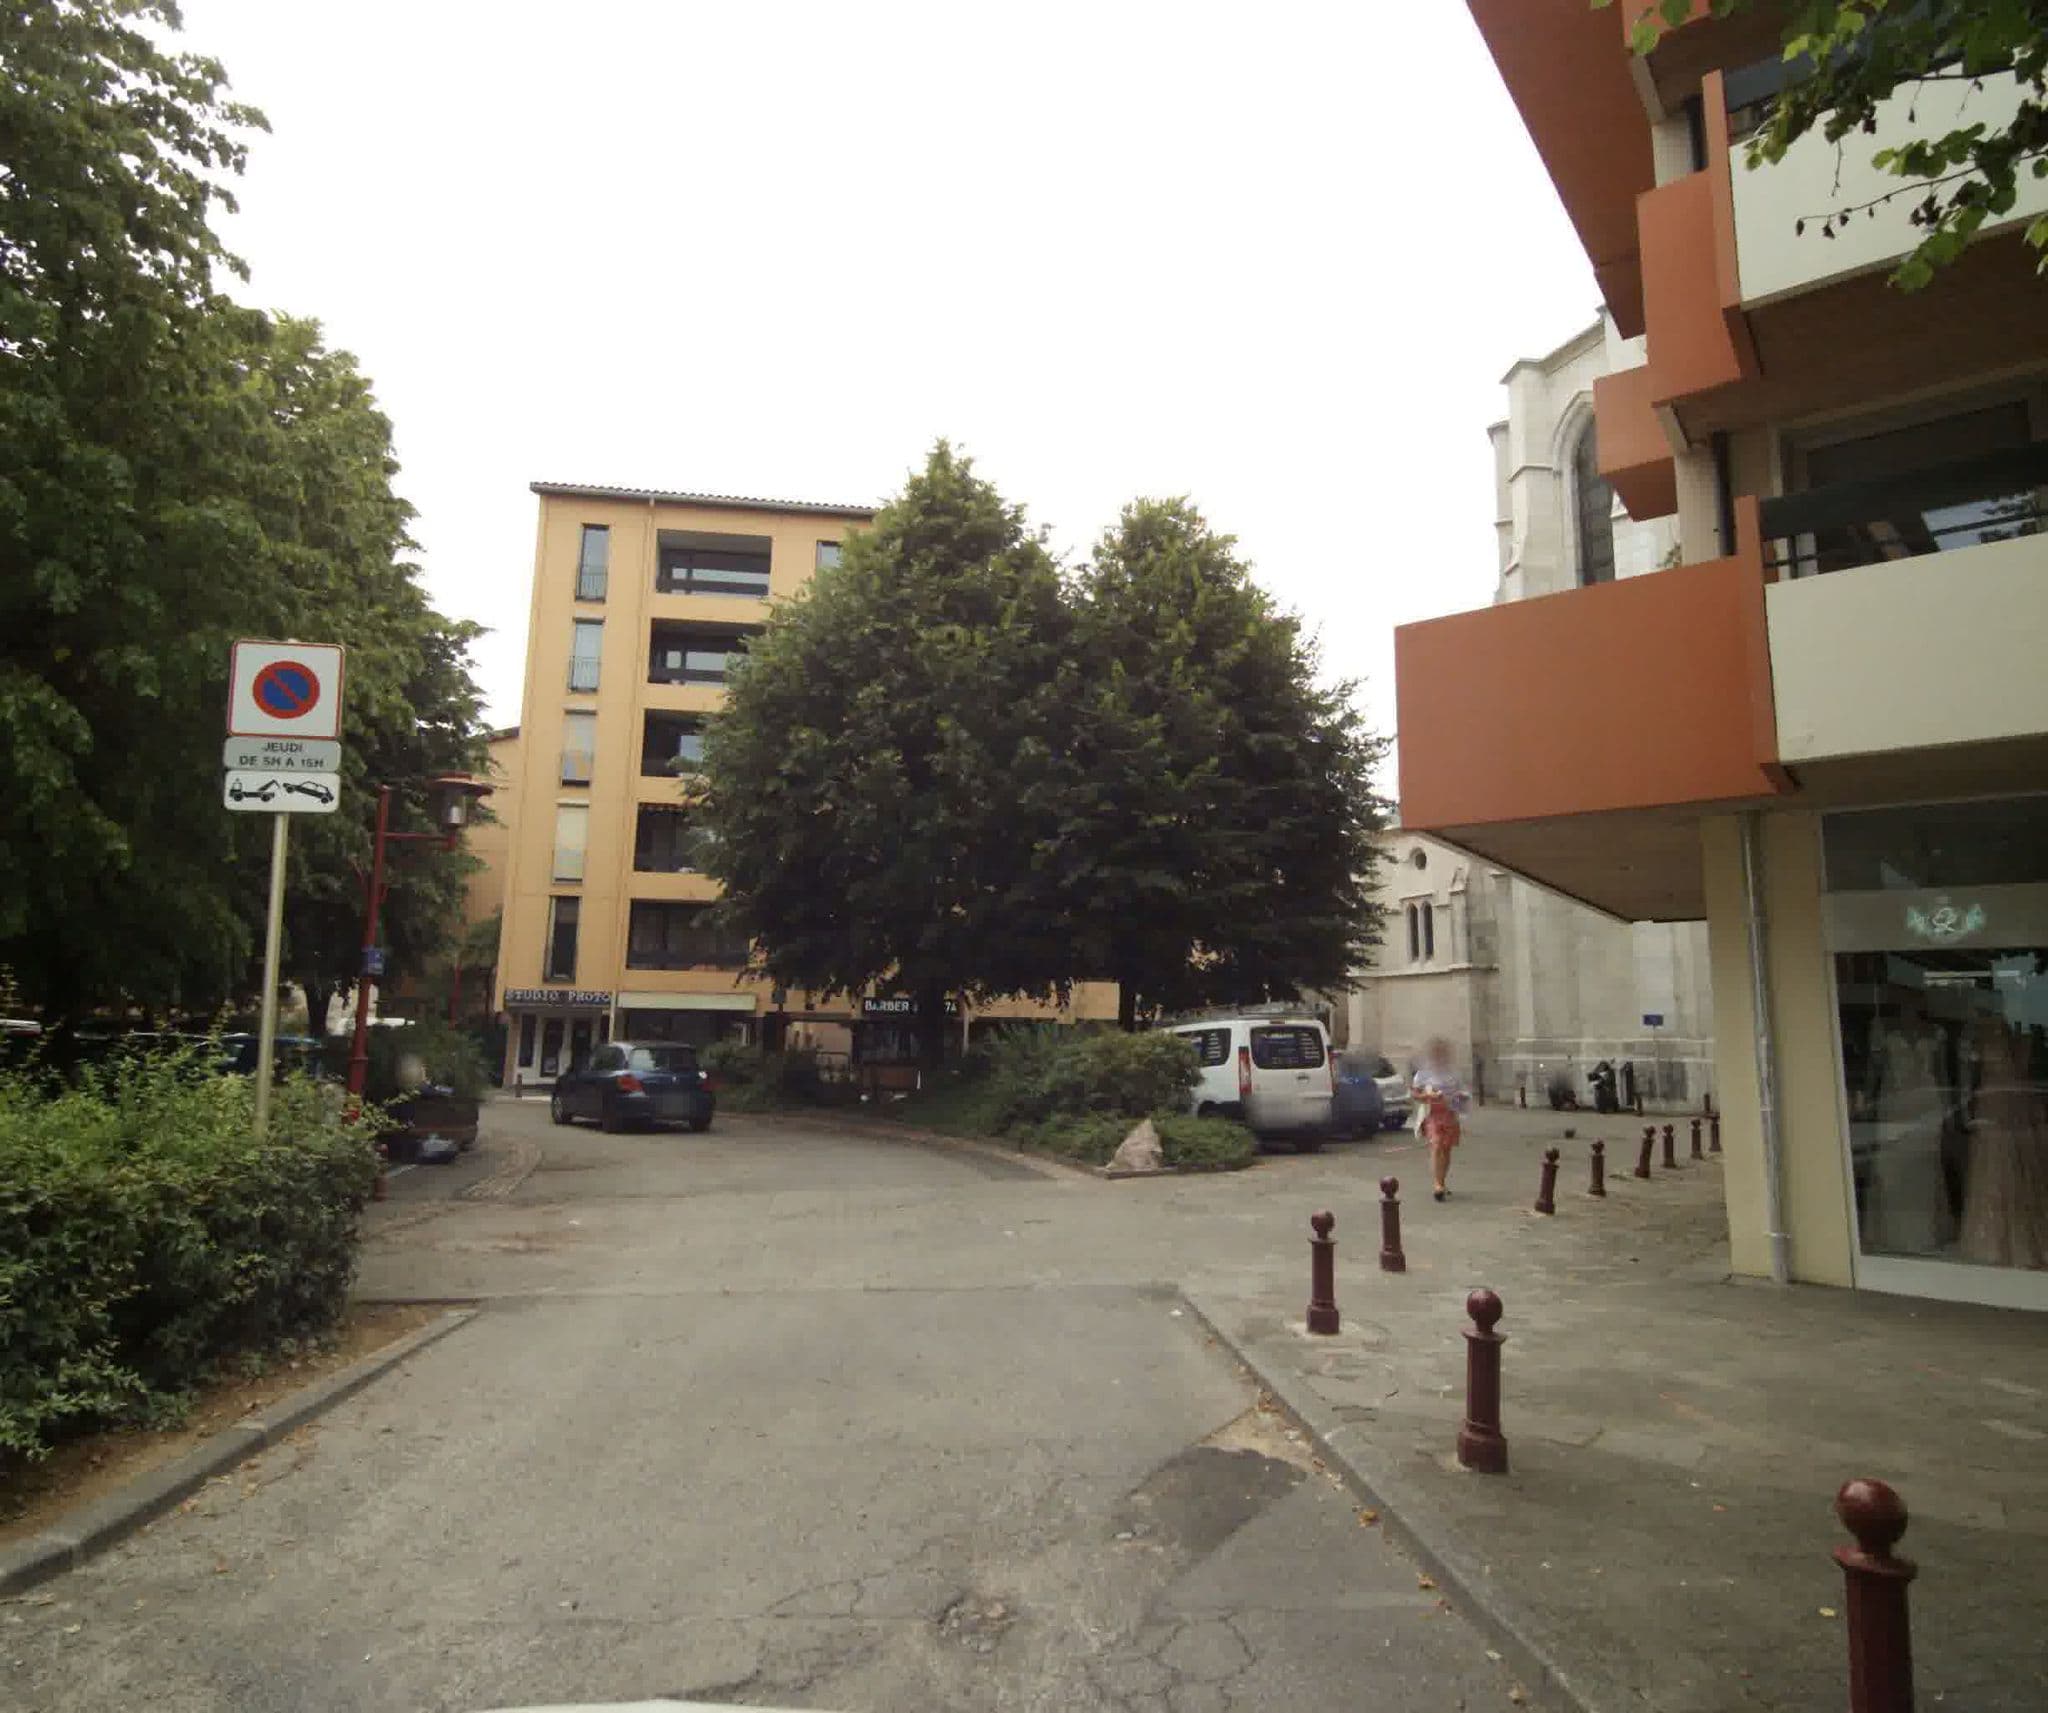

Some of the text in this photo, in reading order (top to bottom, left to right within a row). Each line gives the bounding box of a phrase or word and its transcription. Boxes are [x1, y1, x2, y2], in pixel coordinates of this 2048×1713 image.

[263, 742, 303, 753] JEUDI
[239, 755, 257, 766] DE
[263, 756, 281, 767] 5H
[285, 757, 295, 768] A
[505, 989, 610, 1002] STUDIO PHOTO
[864, 1000, 909, 1011] BARBER
